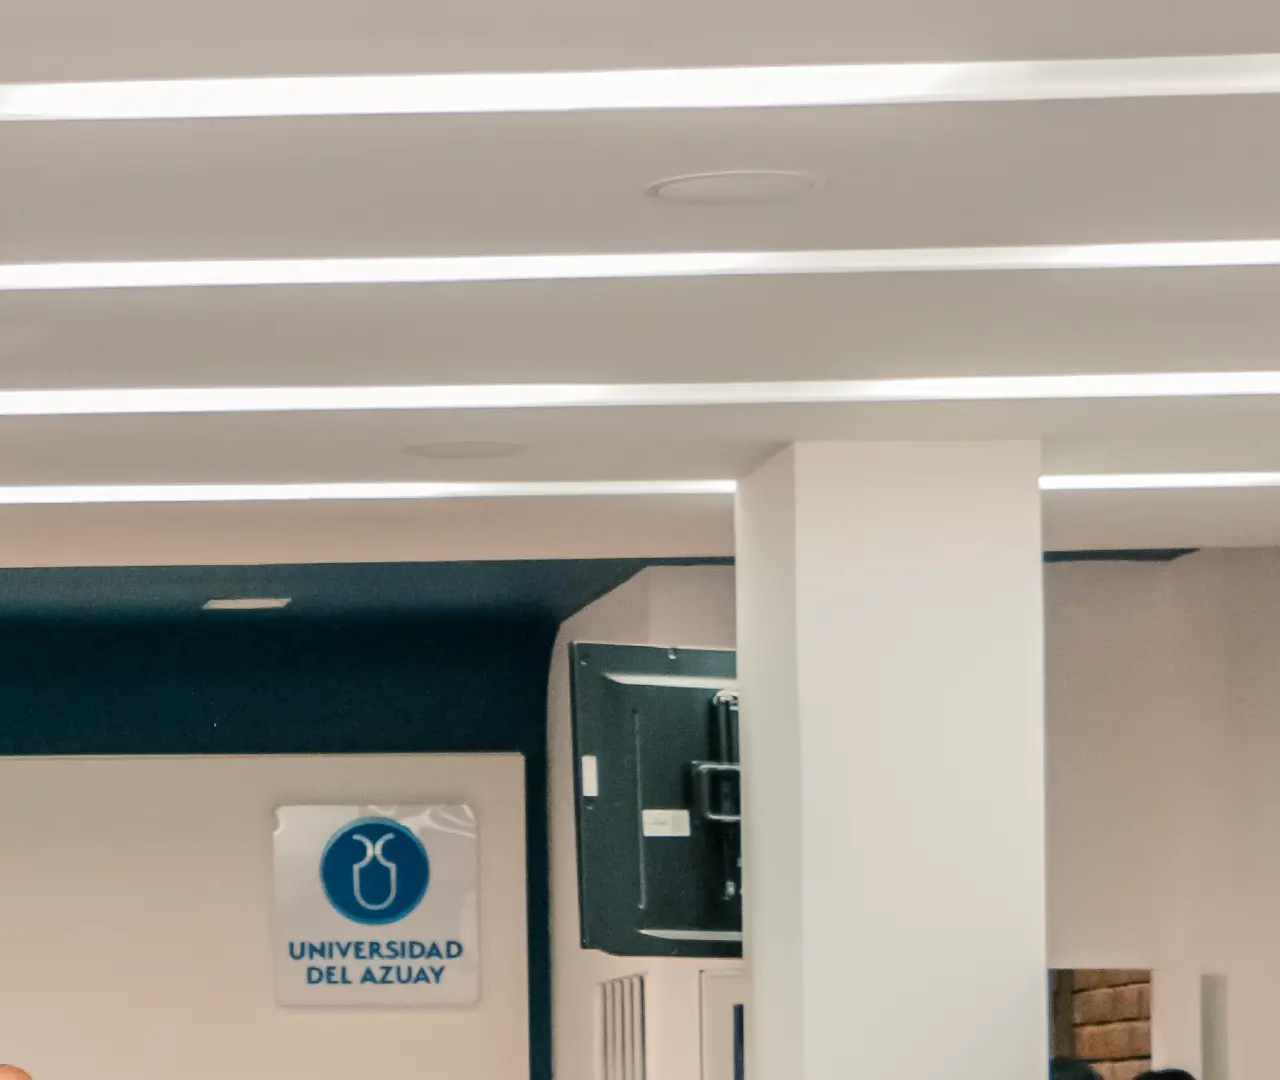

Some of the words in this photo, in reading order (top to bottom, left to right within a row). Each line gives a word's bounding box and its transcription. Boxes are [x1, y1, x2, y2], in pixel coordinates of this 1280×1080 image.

[289, 940, 463, 960] UNIVERSIDAD
[306, 966, 352, 984] DEL
[360, 966, 445, 984] AZUAY
